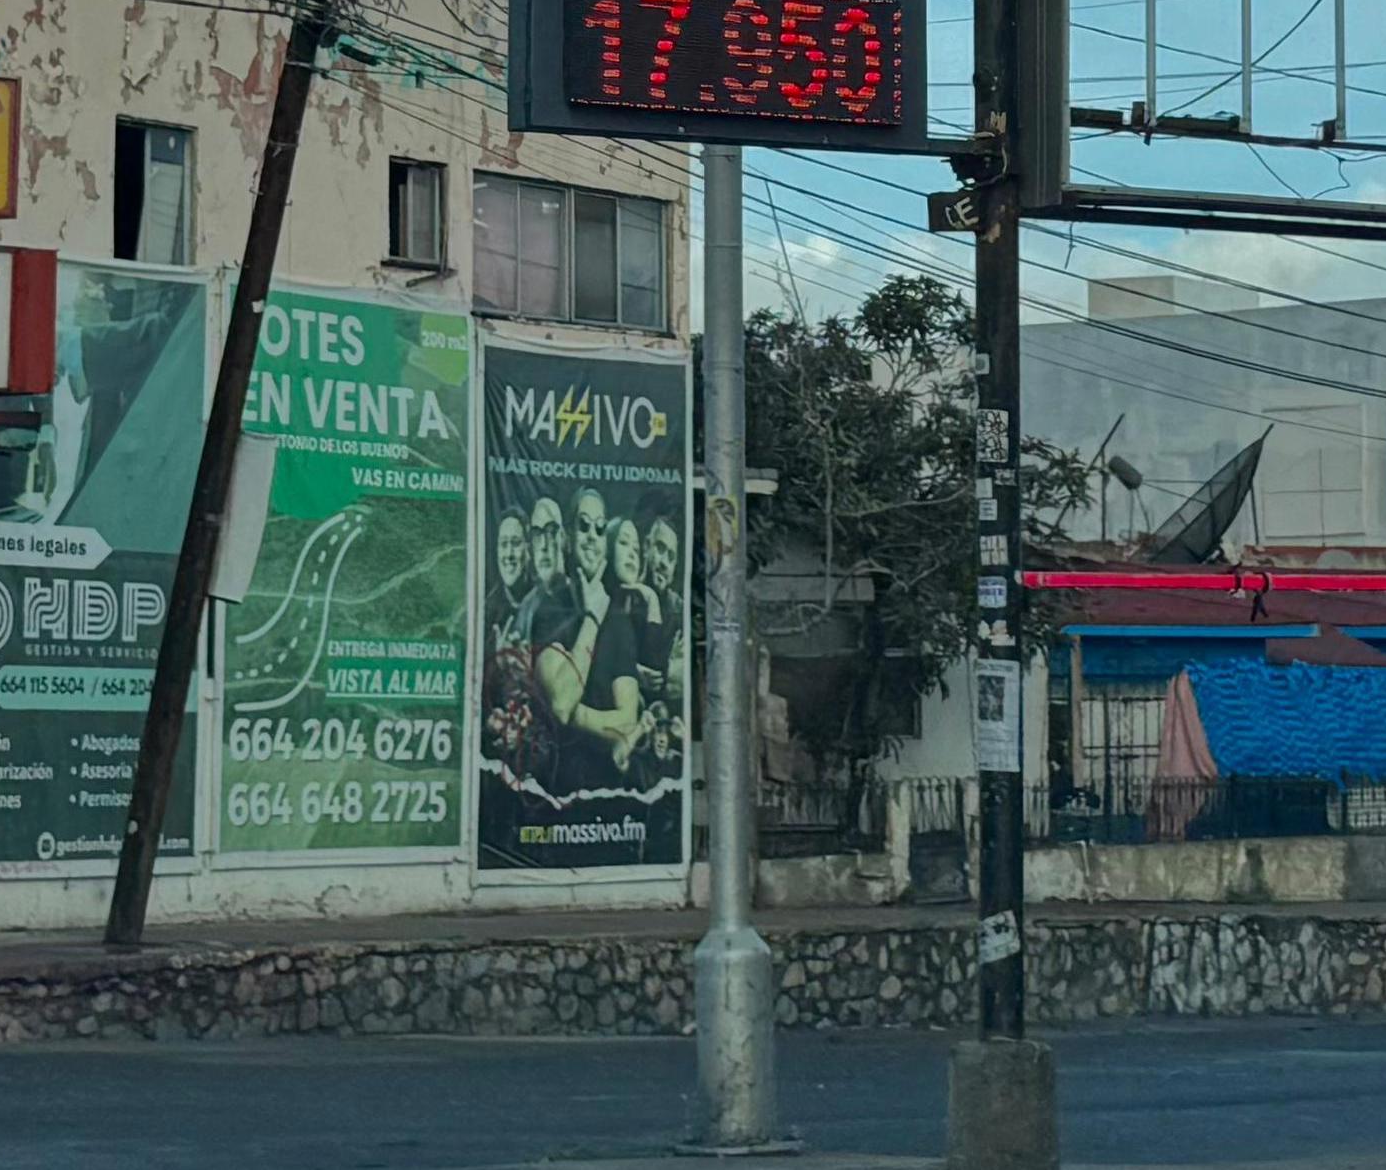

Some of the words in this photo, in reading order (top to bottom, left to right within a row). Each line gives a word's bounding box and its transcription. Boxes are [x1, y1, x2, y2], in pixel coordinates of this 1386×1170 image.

[260, 303, 365, 367] OTES
[241, 370, 292, 425] EN
[303, 377, 450, 440] VENTA
[275, 433, 318, 451] TONIO
[361, 441, 409, 460] BUENOS
[352, 466, 383, 486] VAS
[385, 471, 406, 489] EN
[529, 460, 576, 478] ROCK
[579, 463, 603, 479] EN
[603, 464, 623, 480] TU
[625, 466, 682, 485] IDIOMA
[29, 534, 87, 558] legales
[23, 576, 166, 643] HDP
[327, 639, 387, 658] ENTREGA
[388, 641, 457, 661] INMEDIATA
[0, 674, 26, 694] 664
[29, 675, 49, 694] 115
[51, 675, 85, 695] 5604
[326, 668, 384, 693] VISTA
[387, 669, 411, 694] AL
[414, 670, 458, 695] MAR
[81, 734, 141, 756] Abogados
[229, 717, 295, 762] 664
[301, 717, 368, 762] 204
[373, 718, 453, 762] 6276
[228, 781, 294, 827] 664
[301, 780, 364, 824] 648
[370, 780, 448, 823] 2725
